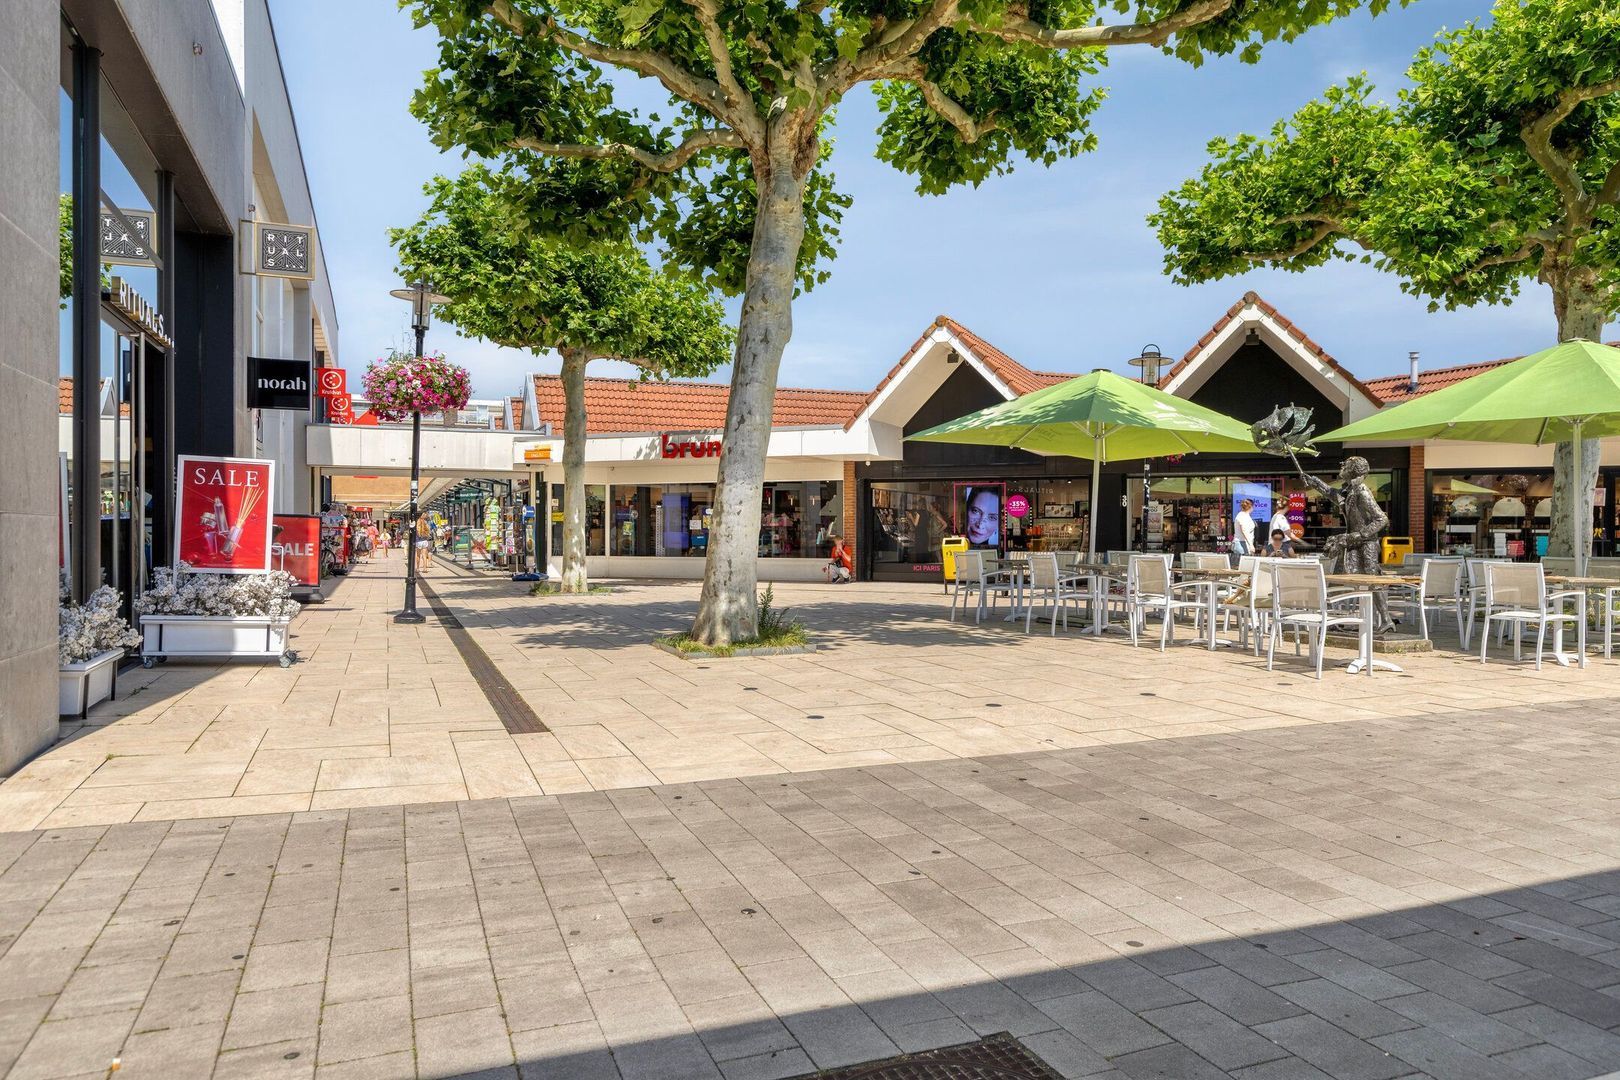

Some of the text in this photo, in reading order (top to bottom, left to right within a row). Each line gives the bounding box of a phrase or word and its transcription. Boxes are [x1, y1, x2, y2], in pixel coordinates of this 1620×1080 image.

[257, 376, 307, 391] norah
[661, 433, 722, 459] brun
[194, 467, 260, 488] SALE
[272, 542, 315, 556] SALE
